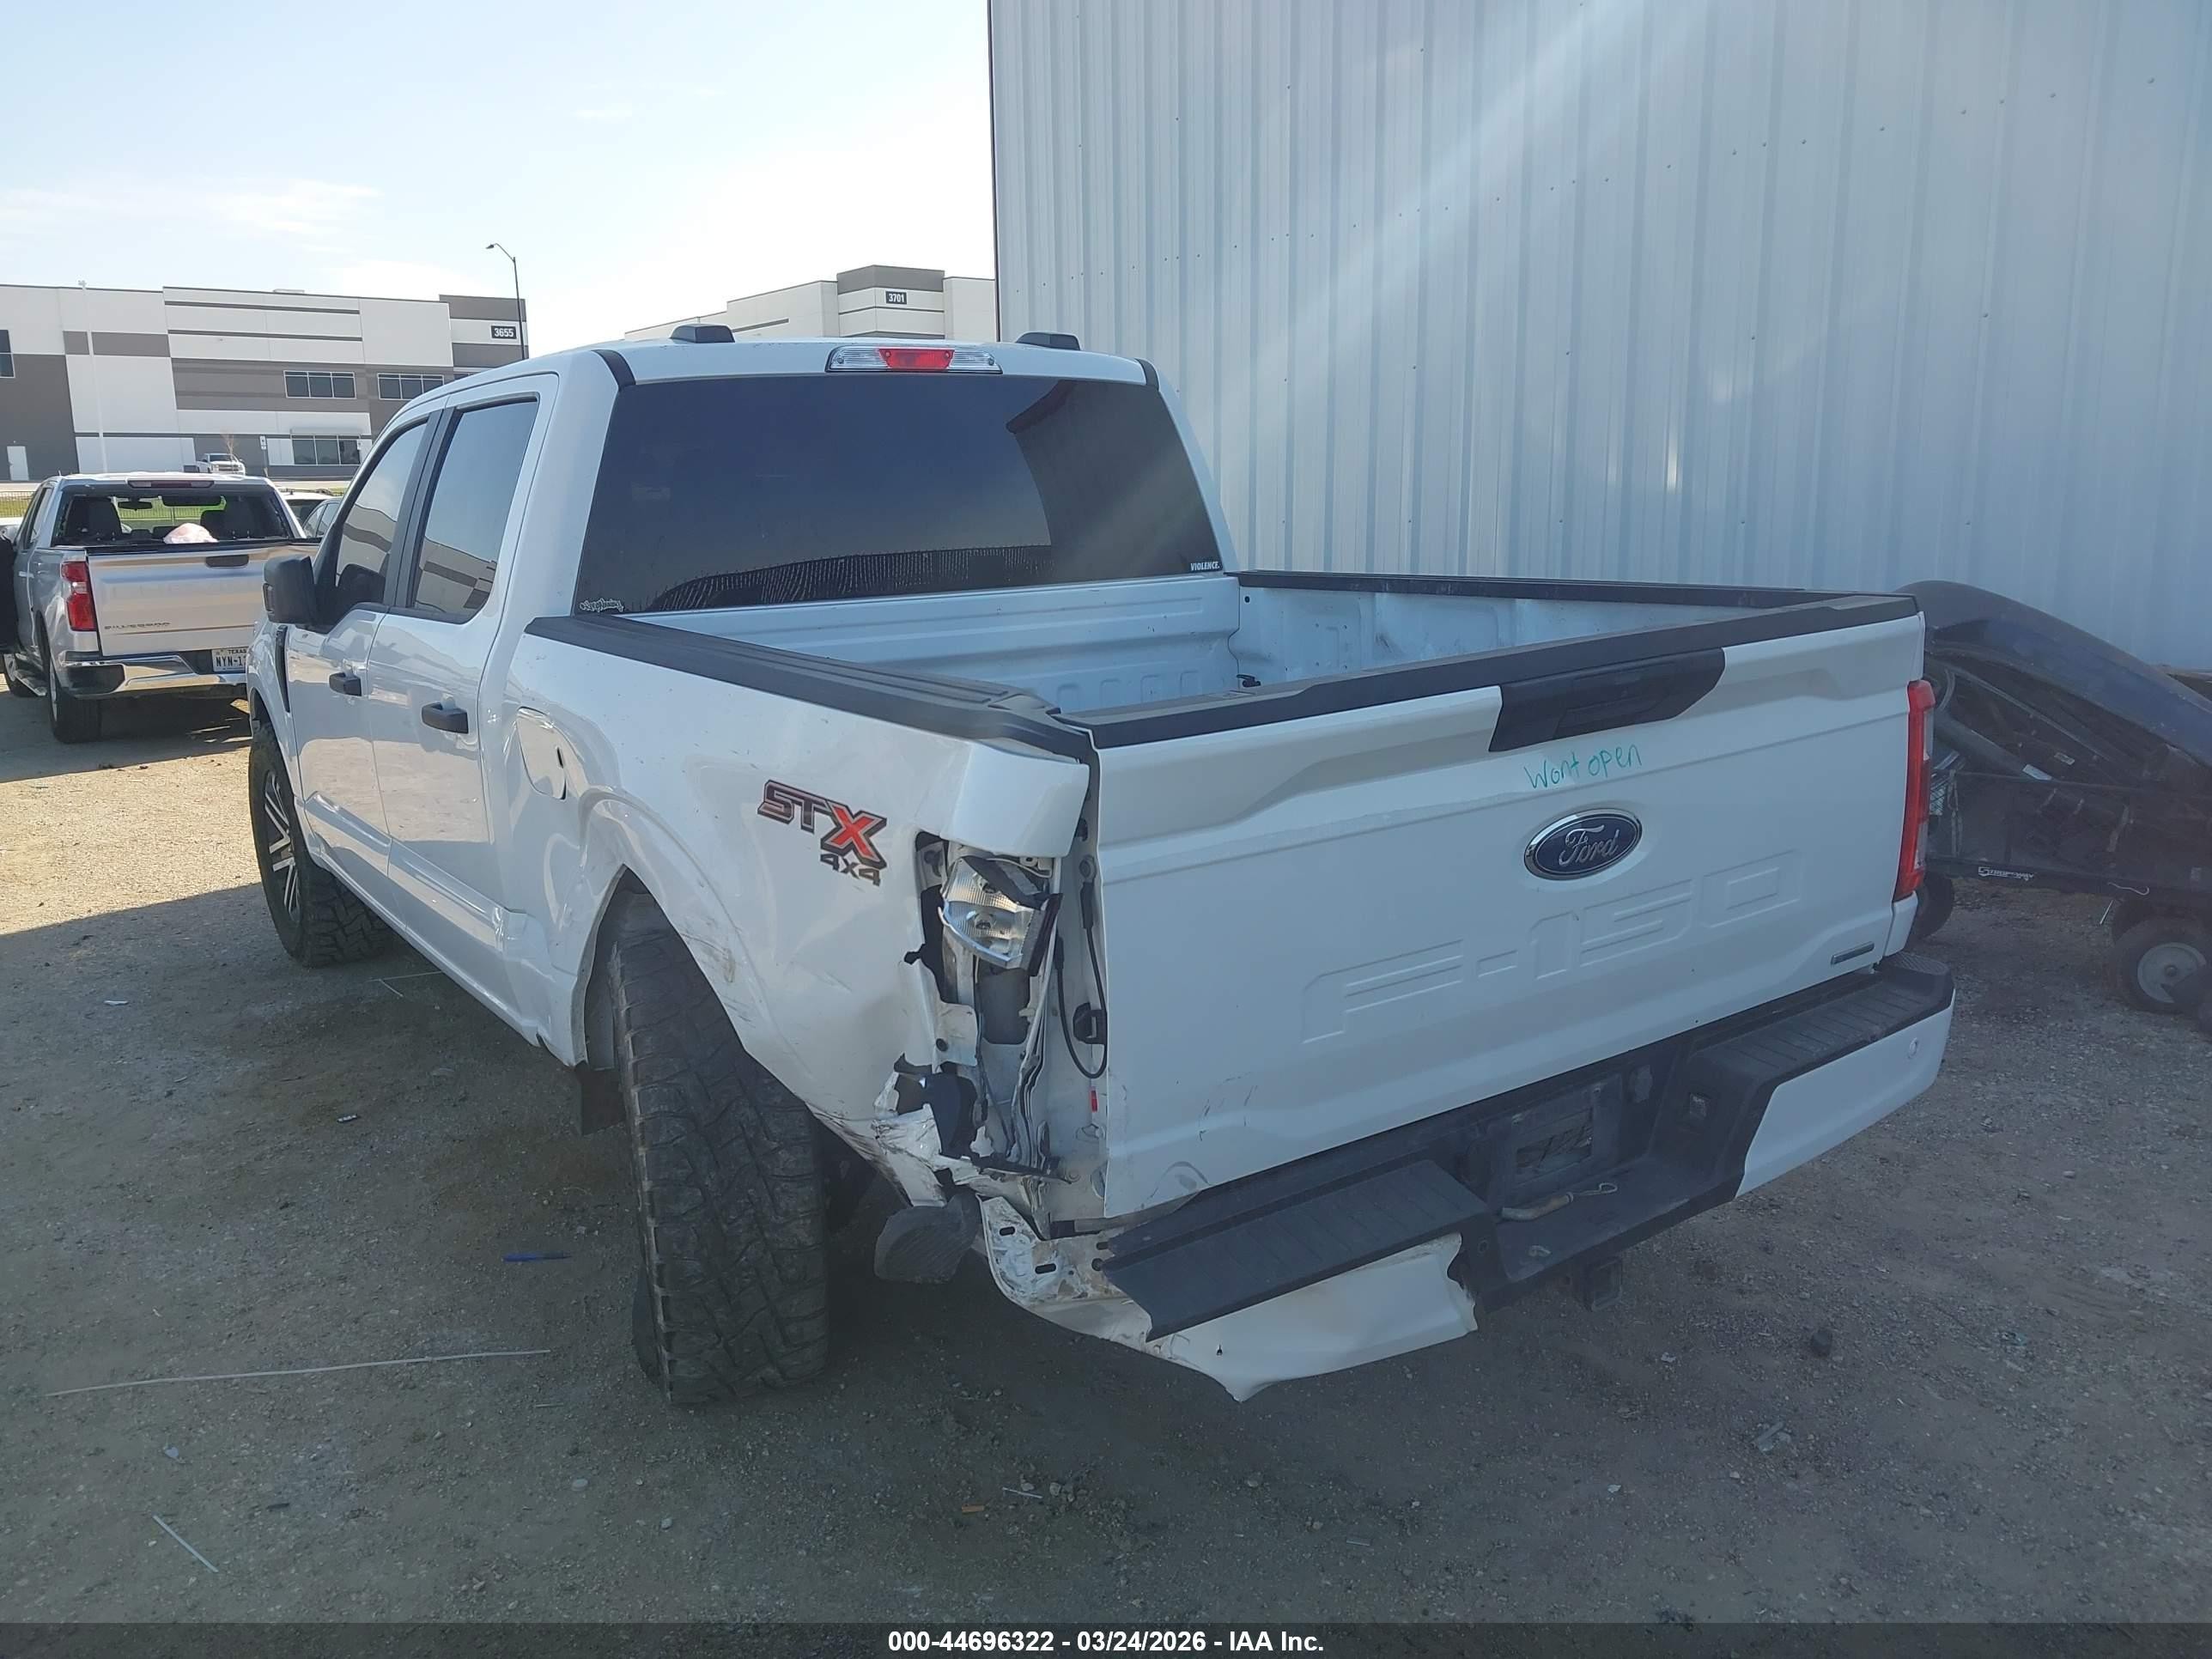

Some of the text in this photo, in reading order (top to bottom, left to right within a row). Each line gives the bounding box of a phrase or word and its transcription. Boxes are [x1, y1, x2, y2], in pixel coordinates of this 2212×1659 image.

[888, 293, 905, 303] 3701
[494, 327, 514, 337] 3655
[757, 779, 888, 870] STX
[1559, 824, 1620, 866] Ford
[1302, 848, 1801, 1044] F-150
